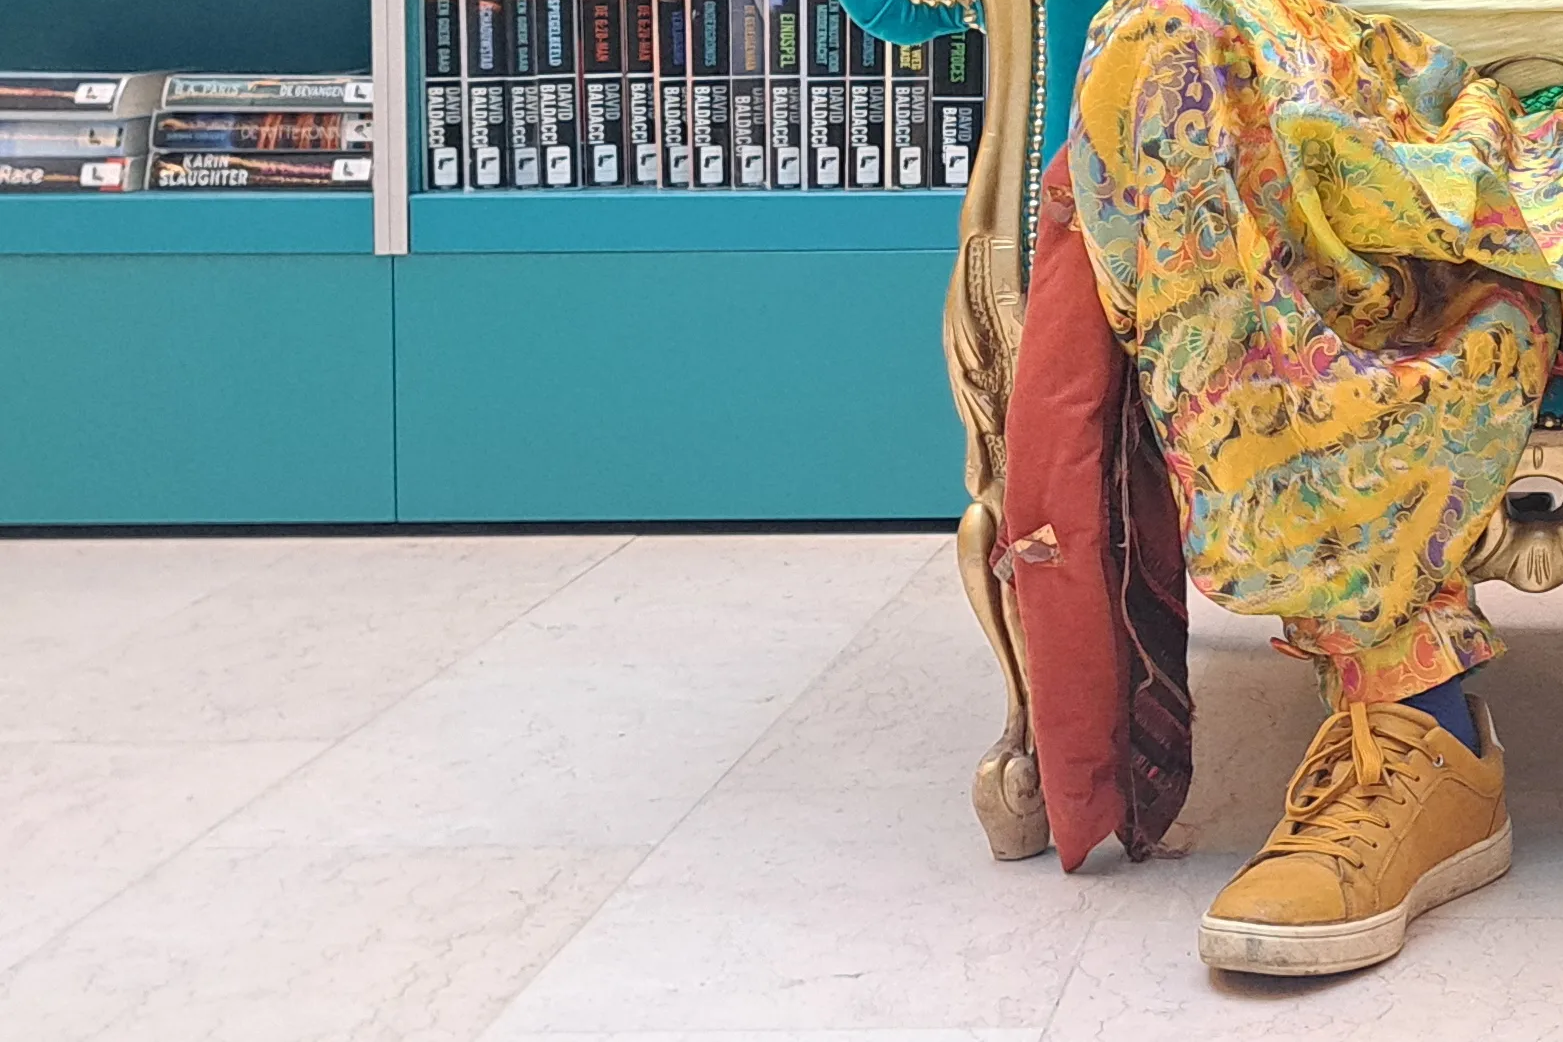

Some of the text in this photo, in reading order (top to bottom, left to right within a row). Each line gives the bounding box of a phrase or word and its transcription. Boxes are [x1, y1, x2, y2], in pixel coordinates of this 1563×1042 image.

[779, 13, 795, 68] EINDSPEL
[428, 87, 445, 148] BALDACCI
[445, 87, 460, 124] DAVID
[471, 87, 487, 148] BALDACCI
[488, 87, 502, 124] DAVID
[512, 87, 524, 148] BALDACCI
[525, 87, 538, 123] DAVID
[541, 84, 557, 145] BALDACCI
[558, 84, 572, 121] DAVID
[587, 84, 604, 144] BALDACCI
[605, 84, 620, 121] DAVID
[631, 83, 647, 143] BALDACCI
[663, 86, 681, 147] BALDACCI
[694, 86, 710, 147] BALDACCI
[712, 86, 726, 122] DAVID
[773, 87, 788, 148] BALDACCI
[811, 87, 827, 148] BALDACCI
[829, 87, 844, 124] DAVID
[851, 87, 868, 147] BALDACCI
[869, 87, 884, 123] DAVID
[894, 87, 910, 147] BALDACCI
[912, 87, 925, 123] DAVID
[958, 107, 972, 142] DAVID
[159, 170, 248, 187] SLAUGHTER
[183, 154, 229, 168] KARIN
